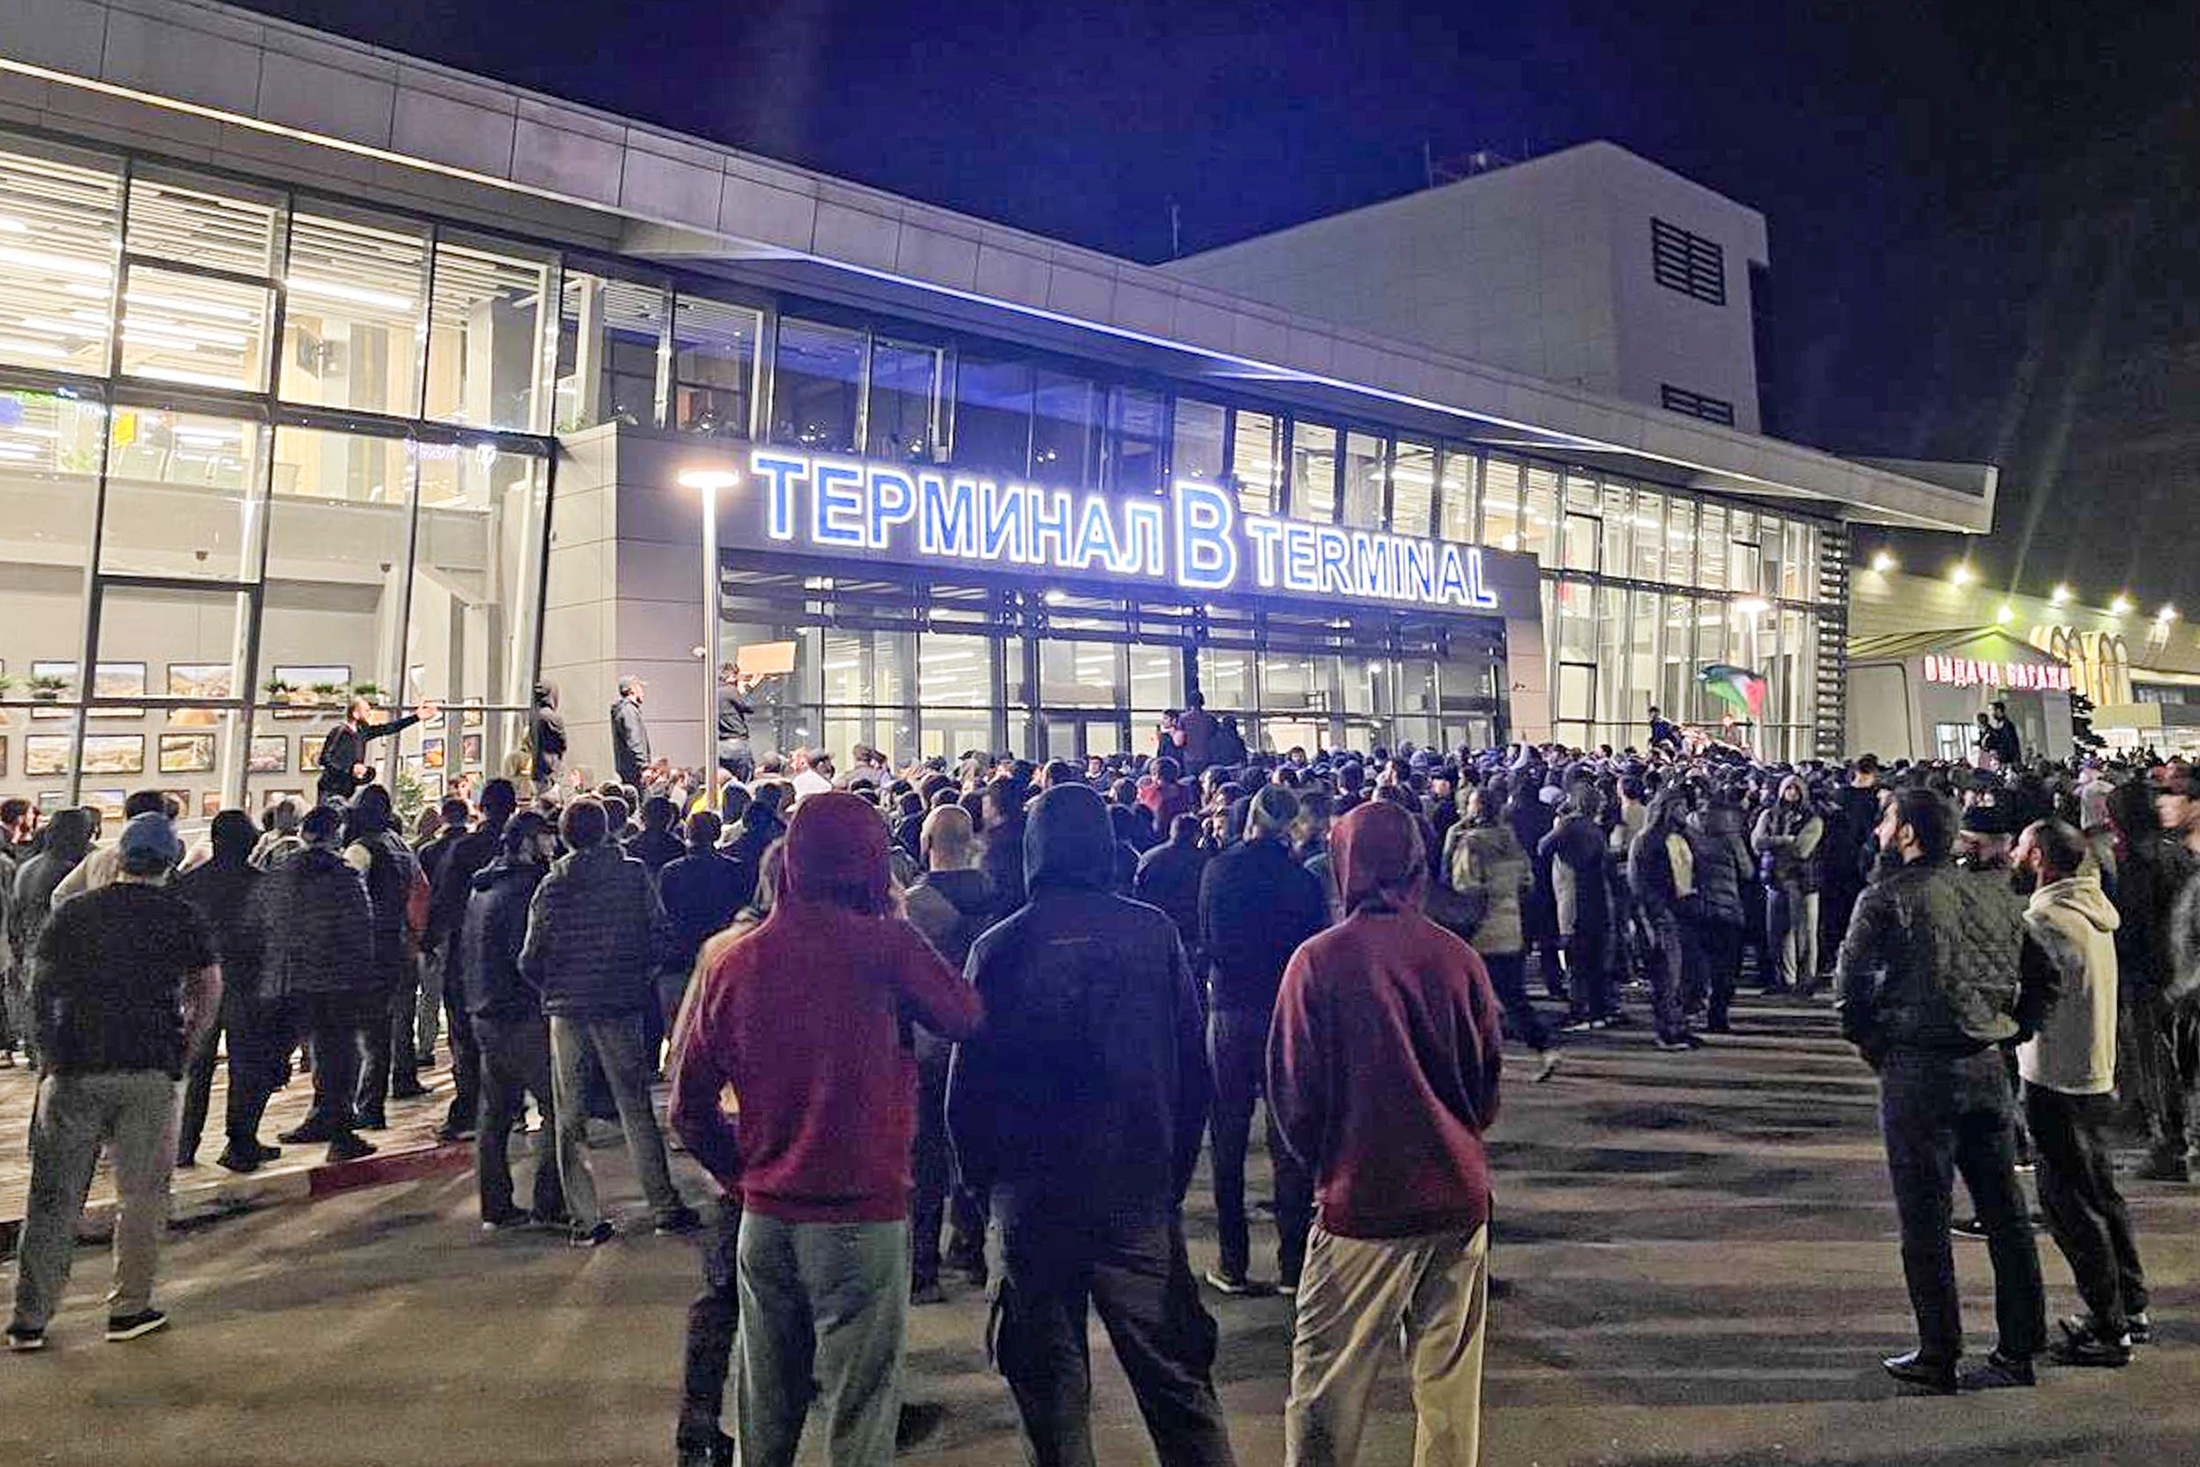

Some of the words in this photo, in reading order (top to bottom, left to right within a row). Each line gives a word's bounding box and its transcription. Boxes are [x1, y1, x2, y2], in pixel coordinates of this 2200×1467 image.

[751, 451, 1164, 576] ТЕРМИНАЛ
[1176, 480, 1237, 590] B
[1245, 517, 1498, 609] TERMINAL
